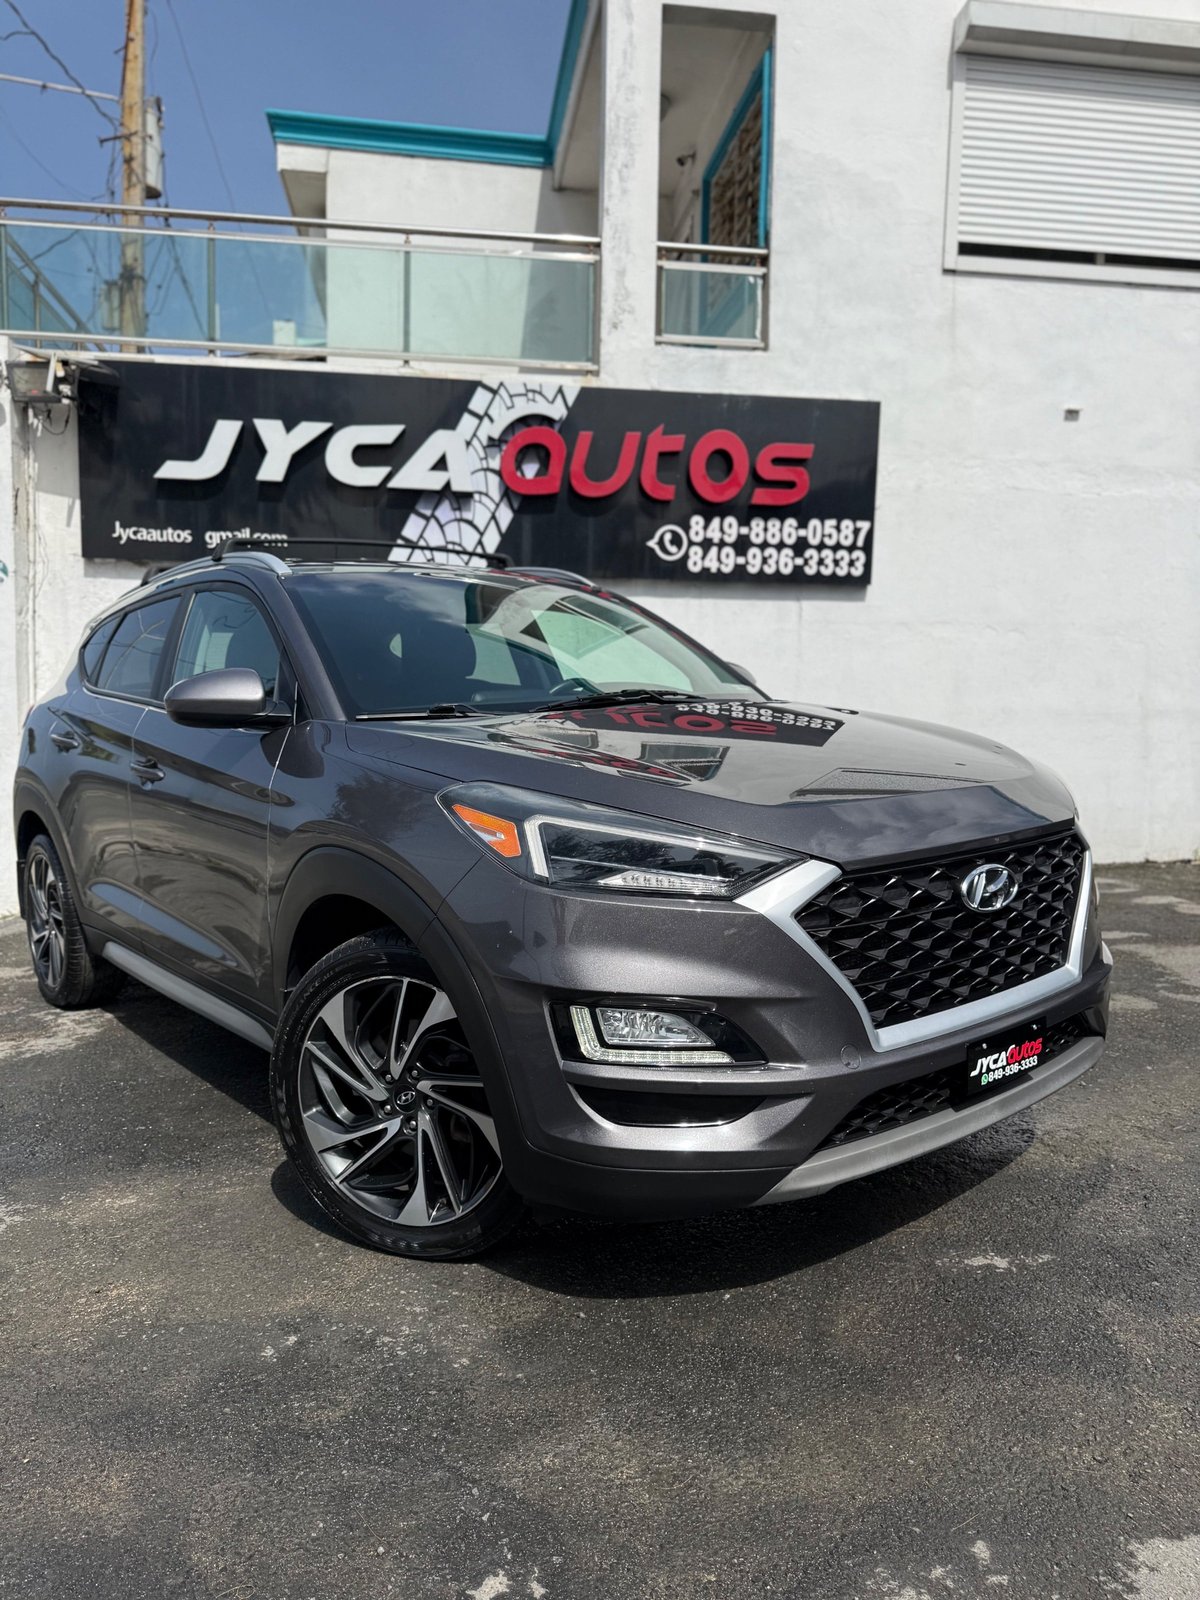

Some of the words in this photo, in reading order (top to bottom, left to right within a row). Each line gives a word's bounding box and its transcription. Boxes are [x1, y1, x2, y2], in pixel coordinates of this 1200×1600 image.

[153, 418, 476, 492] JYCA
[112, 520, 193, 544] Jycaautos
[688, 514, 871, 547] 849-886-0587
[687, 545, 866, 577] 849-936-3333
[970, 1051, 1007, 1077] JYCA
[988, 1055, 1038, 1082] 849-936-3333
